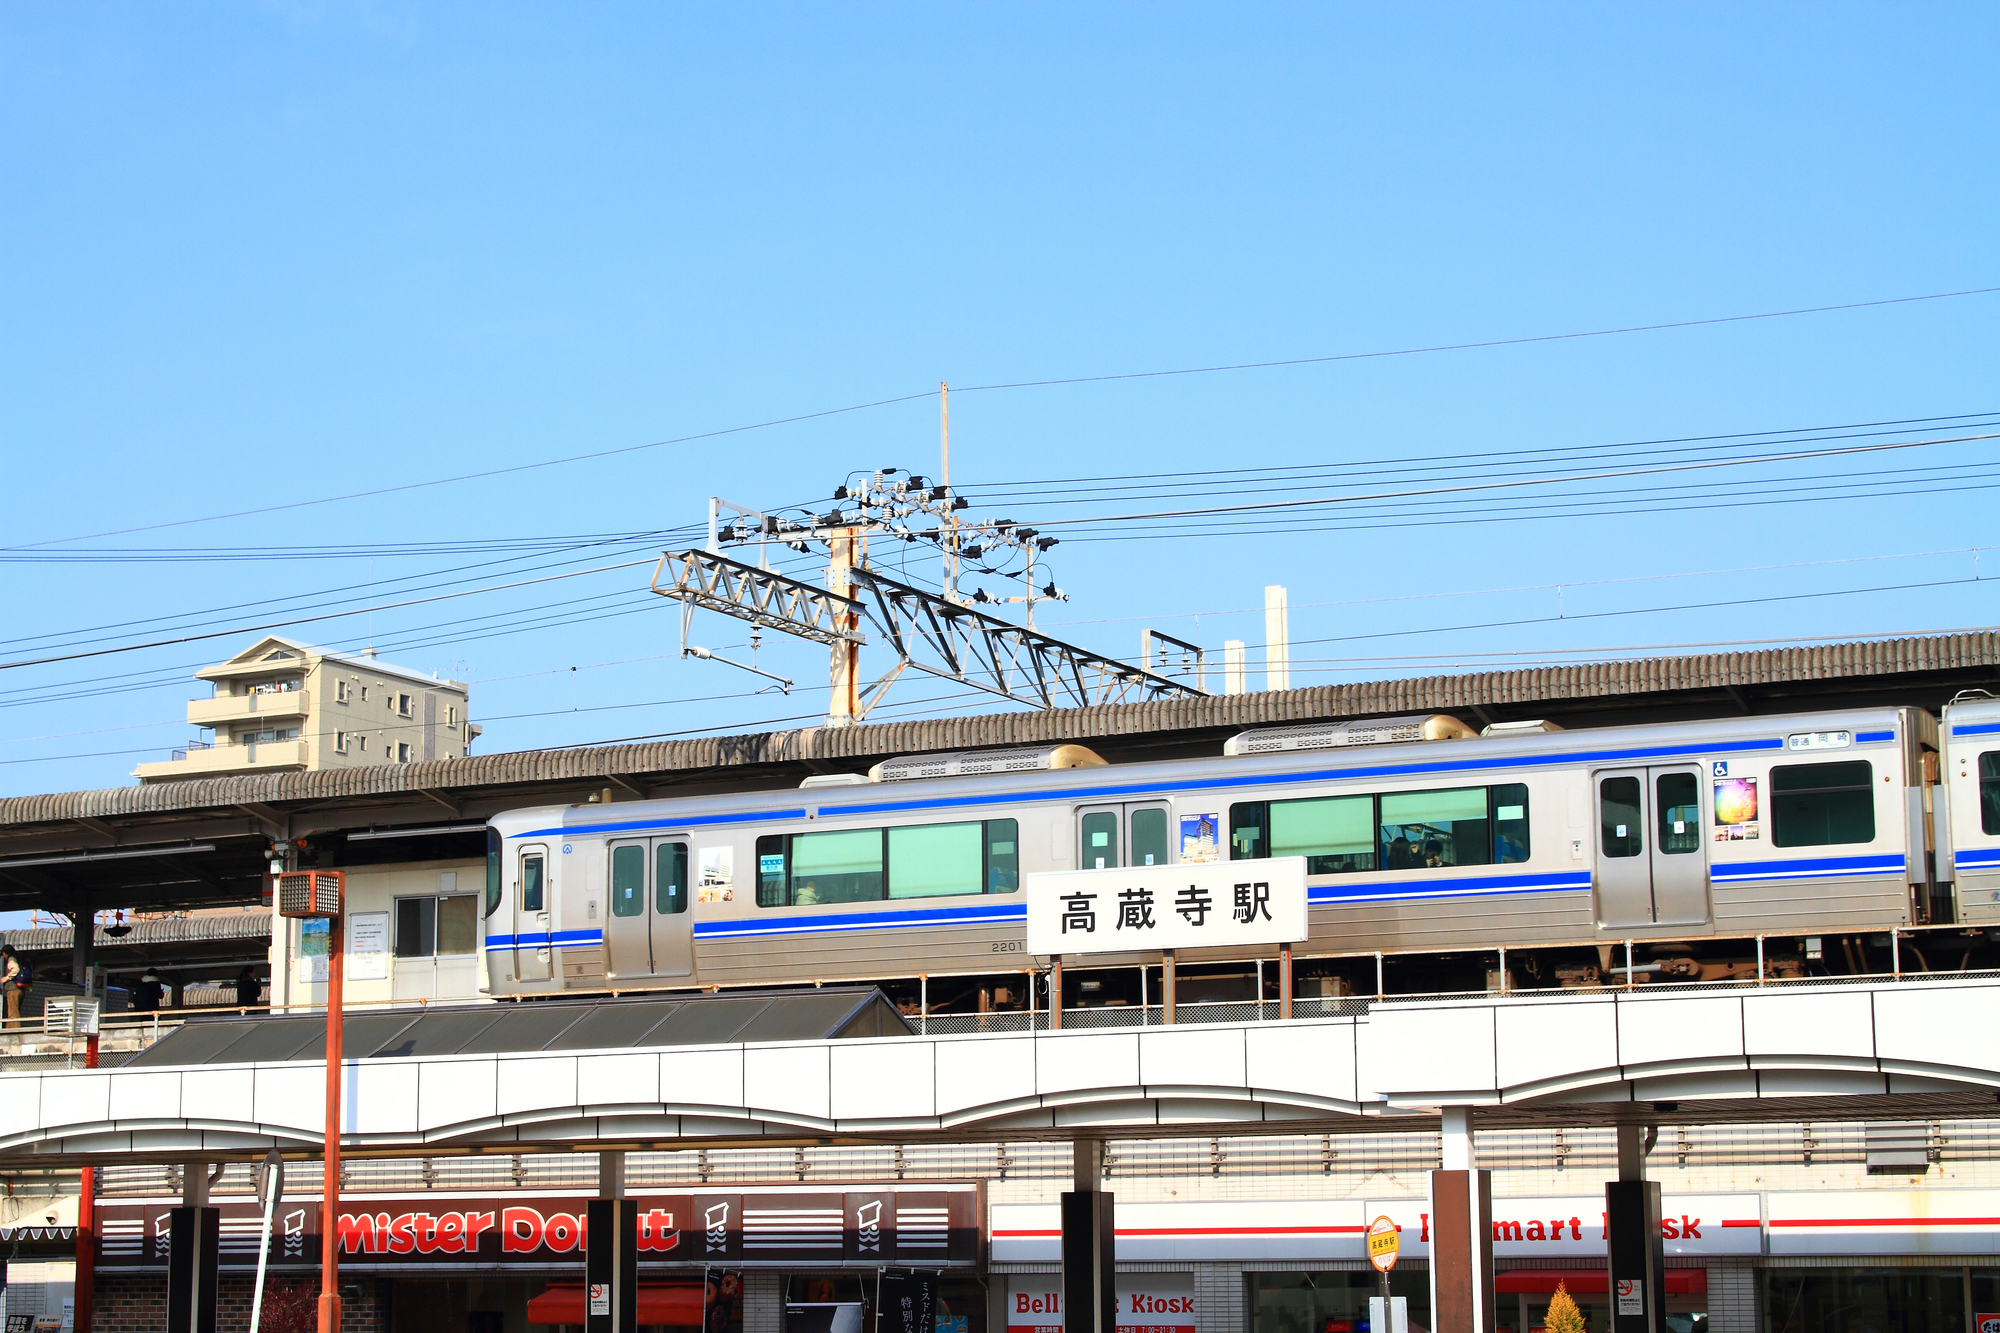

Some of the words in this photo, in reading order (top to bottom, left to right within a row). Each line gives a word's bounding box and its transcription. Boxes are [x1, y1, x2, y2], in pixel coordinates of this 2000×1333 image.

[1059, 882, 1273, 934] 高蔵寺駅
[992, 942, 1022, 952] 2201
[502, 1206, 680, 1254] Dot
[1131, 1294, 1194, 1313] Kiosk
